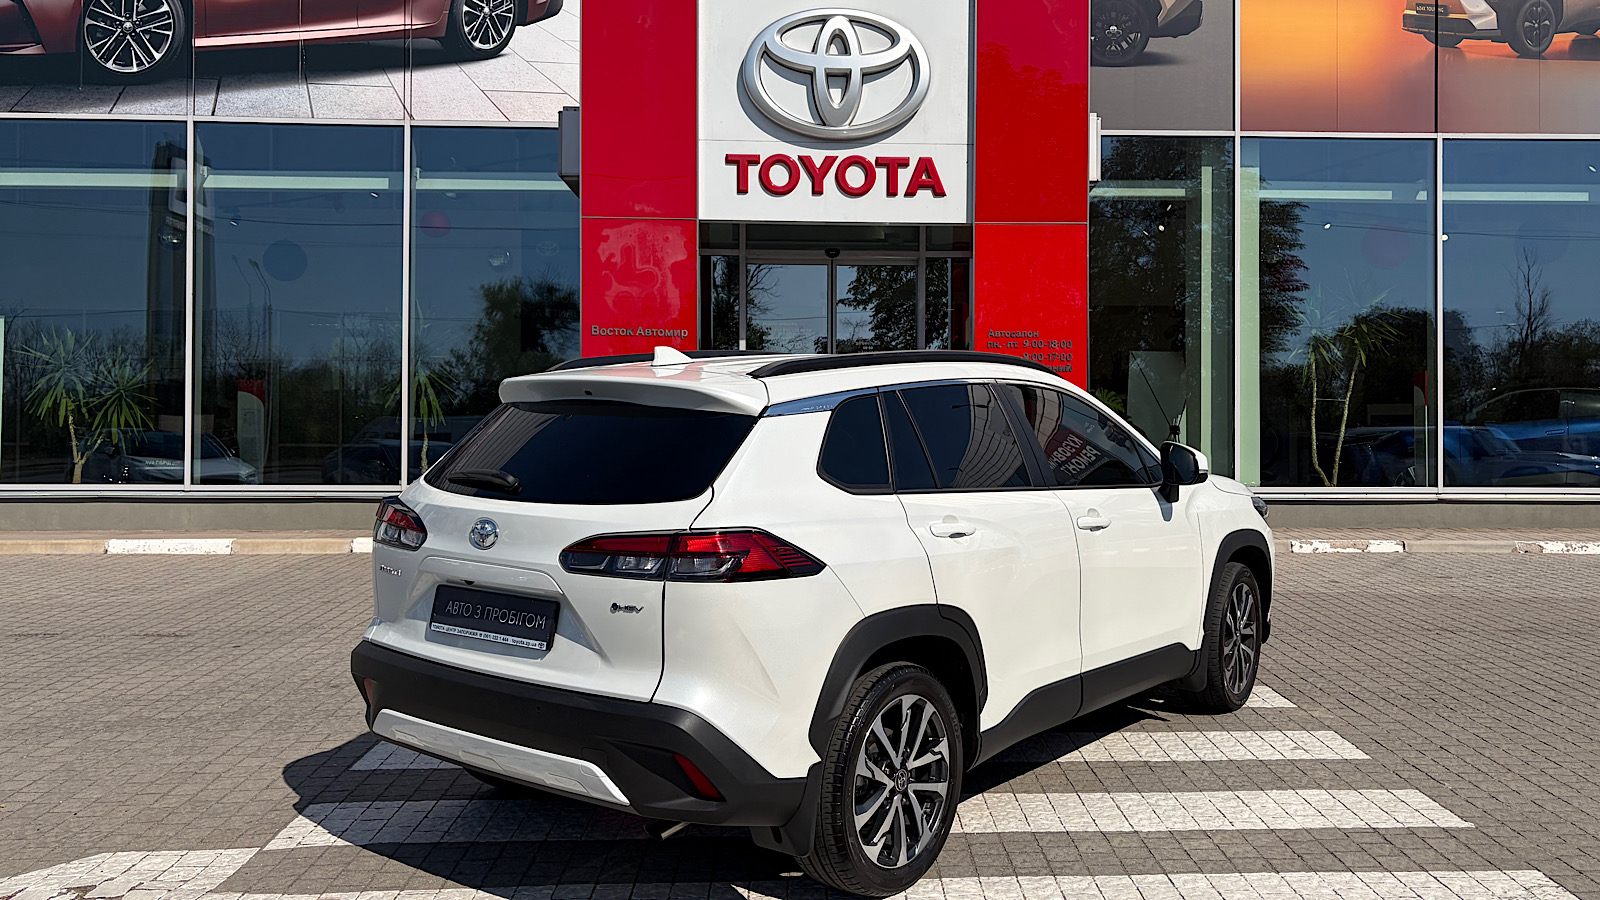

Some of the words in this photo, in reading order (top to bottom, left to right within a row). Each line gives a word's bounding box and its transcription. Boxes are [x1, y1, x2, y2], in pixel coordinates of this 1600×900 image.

[725, 153, 947, 198] TOYOTA
[591, 325, 634, 336] Восток
[636, 326, 689, 340] Автомир
[987, 329, 1040, 338] Автосалон
[1022, 340, 1073, 349] 9:00-18:00
[1022, 353, 1073, 362] 9:00-17:00
[445, 600, 473, 617] АВТО
[473, 604, 482, 619] З
[483, 606, 547, 630] ПРОБІГОМ
